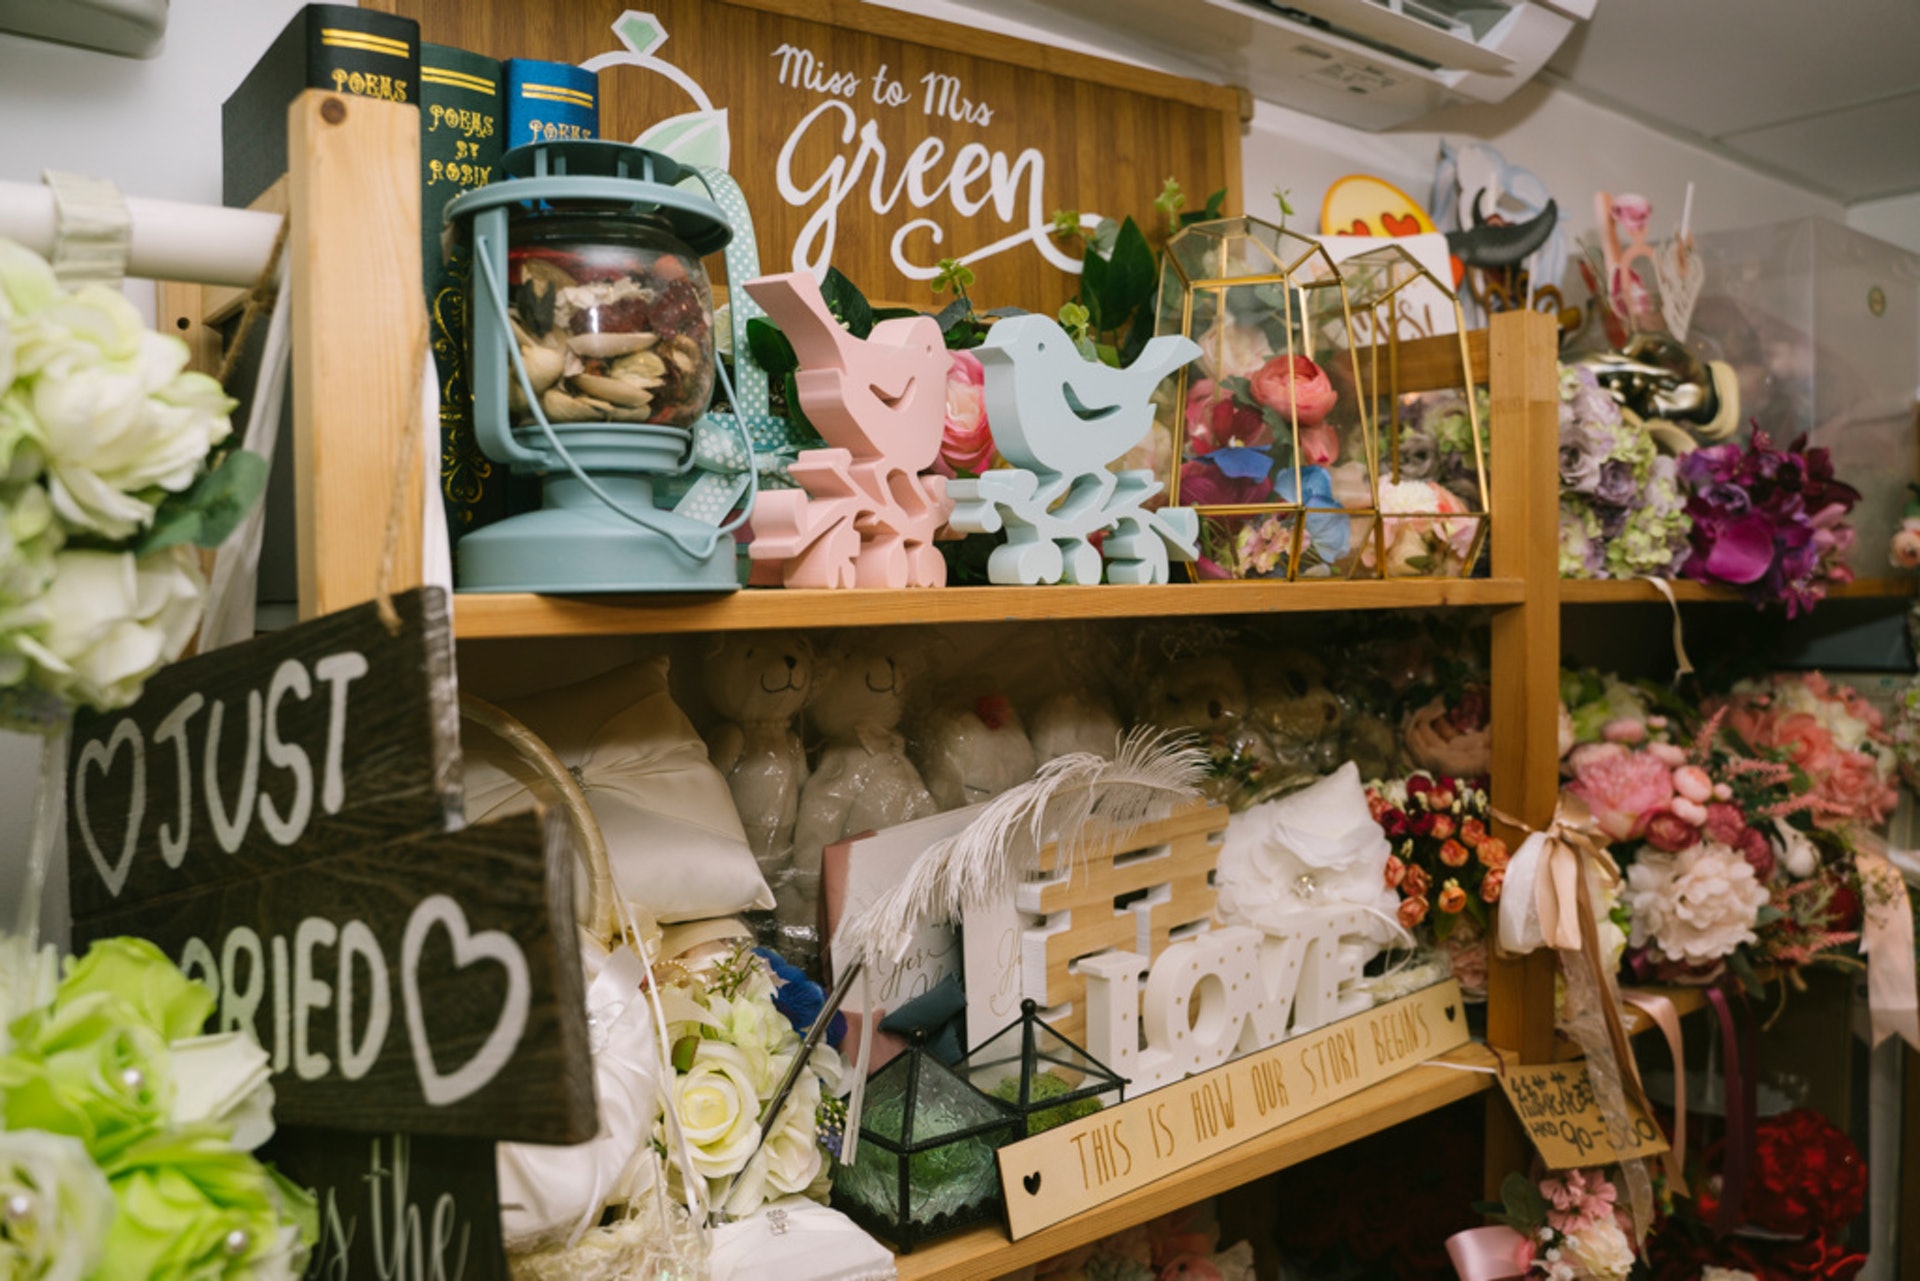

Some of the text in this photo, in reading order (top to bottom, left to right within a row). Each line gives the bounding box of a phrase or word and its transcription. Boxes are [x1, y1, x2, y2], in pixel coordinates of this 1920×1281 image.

[331, 67, 408, 102] POEMS
[428, 104, 494, 138] POEMS
[455, 140, 480, 160] BY
[770, 43, 994, 127] Miss to Mrs
[427, 159, 492, 190] ROBIN
[776, 99, 1084, 286] Green
[154, 651, 369, 869] JUST
[180, 916, 392, 1081] RIED
[1069, 904, 1374, 1102] LOVE
[1070, 1003, 1432, 1191] THIS IS HOW OUR STORY BEGINS
[361, 1132, 471, 1281] the
